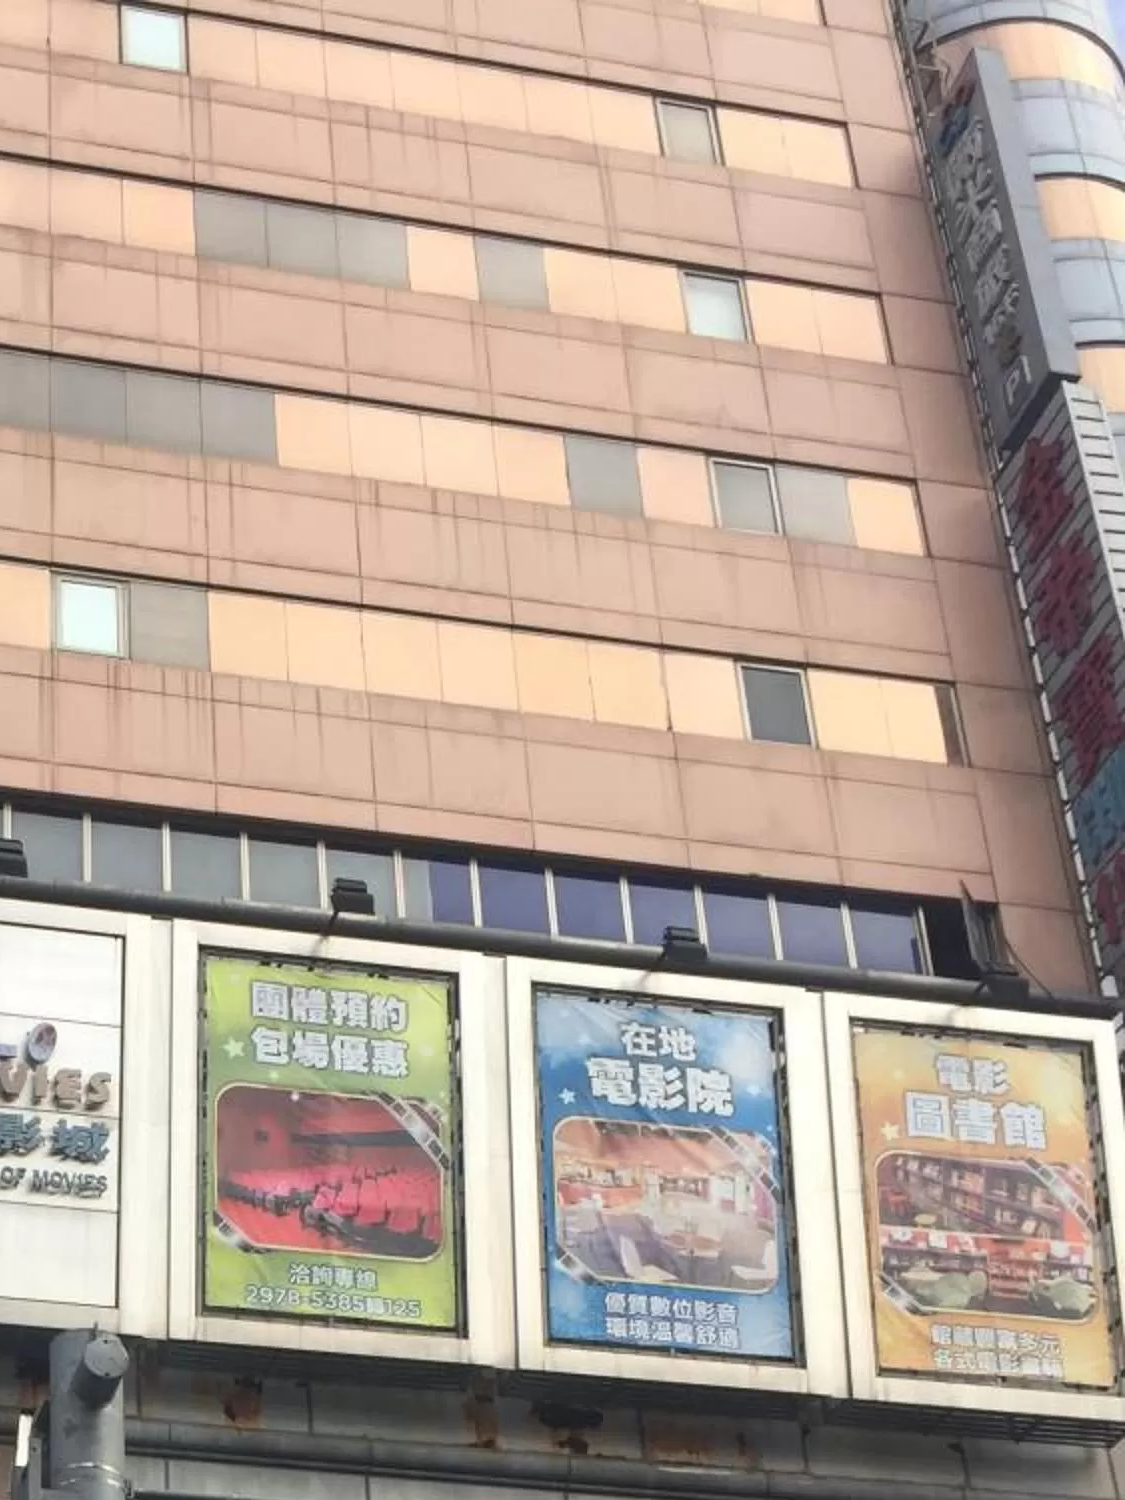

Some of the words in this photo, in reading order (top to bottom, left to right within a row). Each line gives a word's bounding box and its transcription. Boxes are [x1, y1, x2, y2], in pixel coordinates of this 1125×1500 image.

[249, 980, 409, 1033] 團體預約
[249, 1027, 410, 1079] 包場優惠
[620, 1021, 696, 1063] 在地
[586, 1057, 735, 1118] 電影院
[935, 1054, 1010, 1095] 電影
[905, 1090, 1047, 1150] 圖書館
[0, 1167, 27, 1187] OF
[31, 1170, 108, 1197] MOVIES
